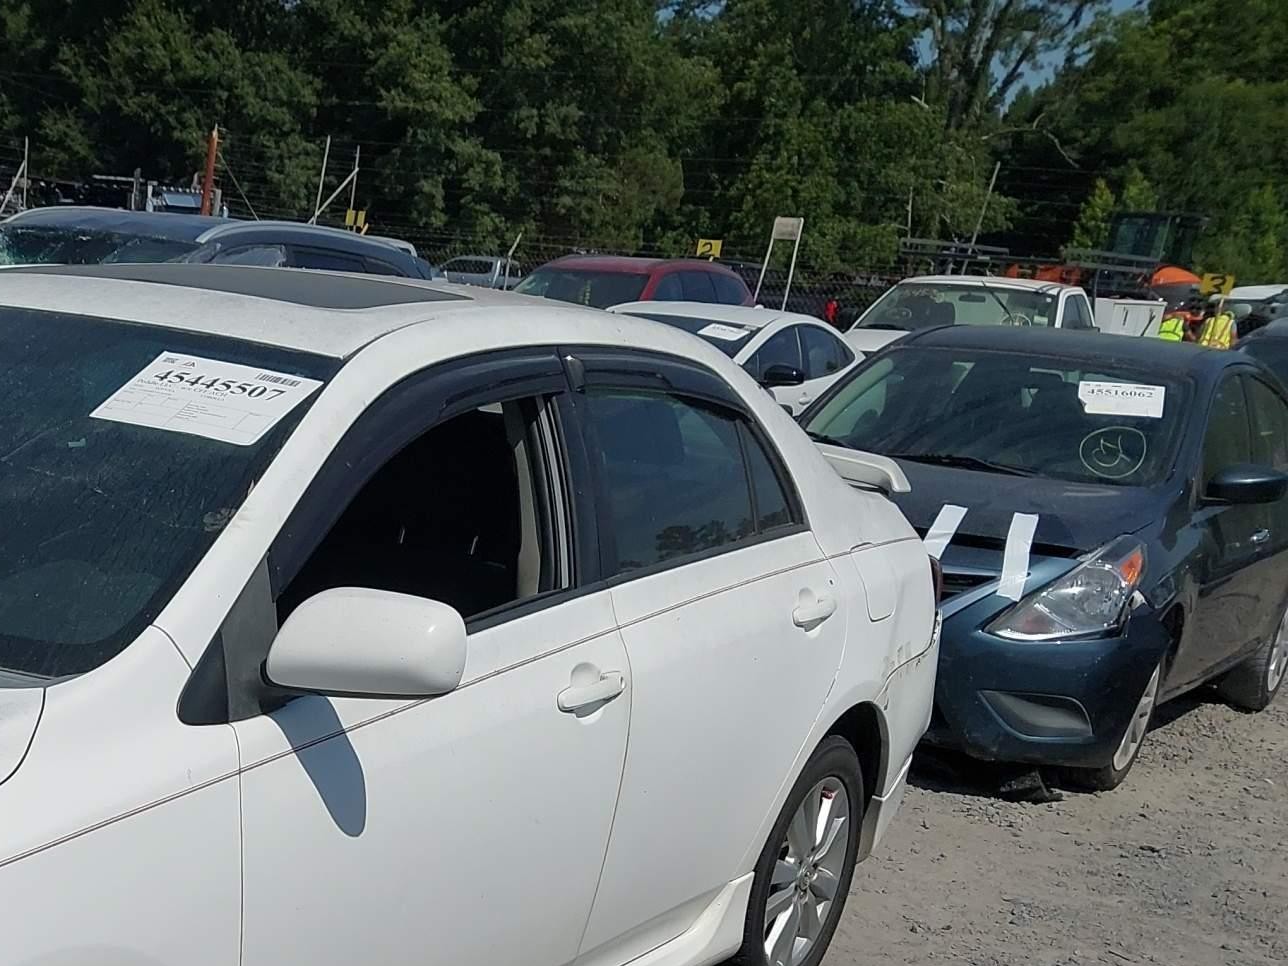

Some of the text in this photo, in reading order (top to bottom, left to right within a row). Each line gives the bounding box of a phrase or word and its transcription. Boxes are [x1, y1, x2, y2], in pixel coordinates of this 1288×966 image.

[700, 242, 714, 257] 2
[154, 369, 287, 402] 45445507
[1087, 388, 1154, 398] 45516062
